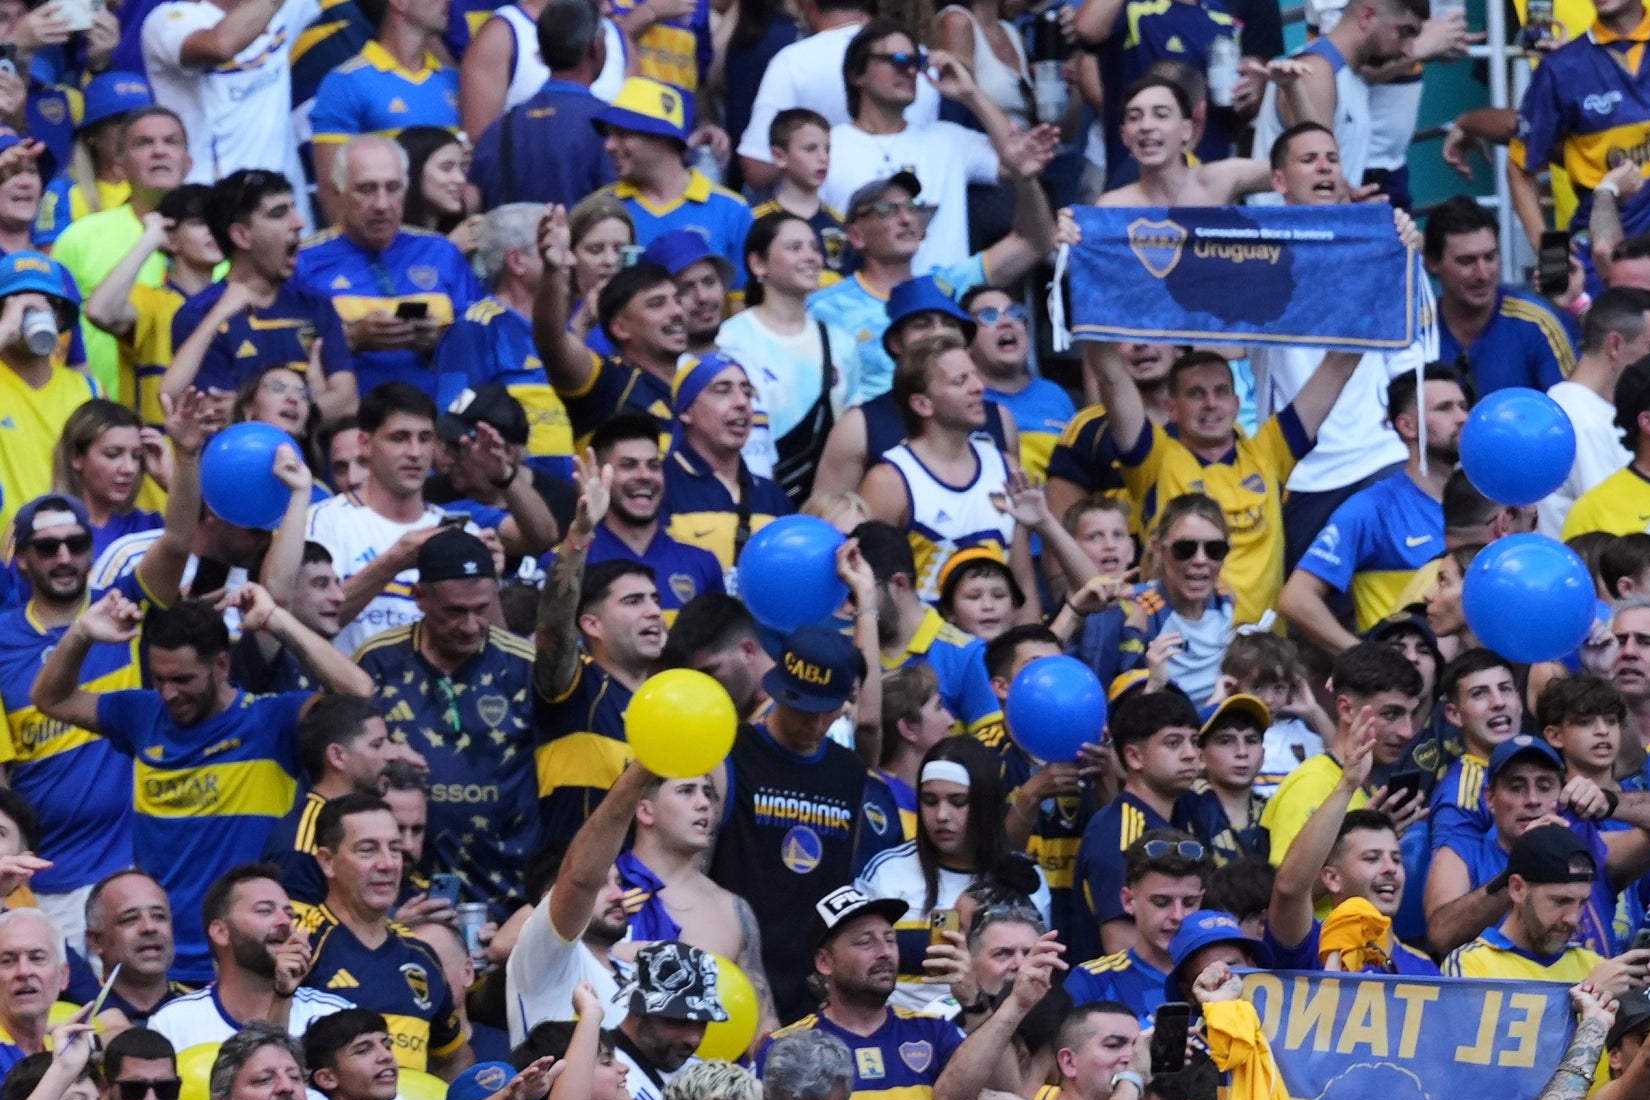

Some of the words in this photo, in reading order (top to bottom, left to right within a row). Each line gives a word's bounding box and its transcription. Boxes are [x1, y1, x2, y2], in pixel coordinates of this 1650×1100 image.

[1194, 243, 1280, 264] Uruguay
[785, 651, 832, 686] CABJ
[431, 784, 499, 803] sson
[754, 793, 851, 831] WARRIORS
